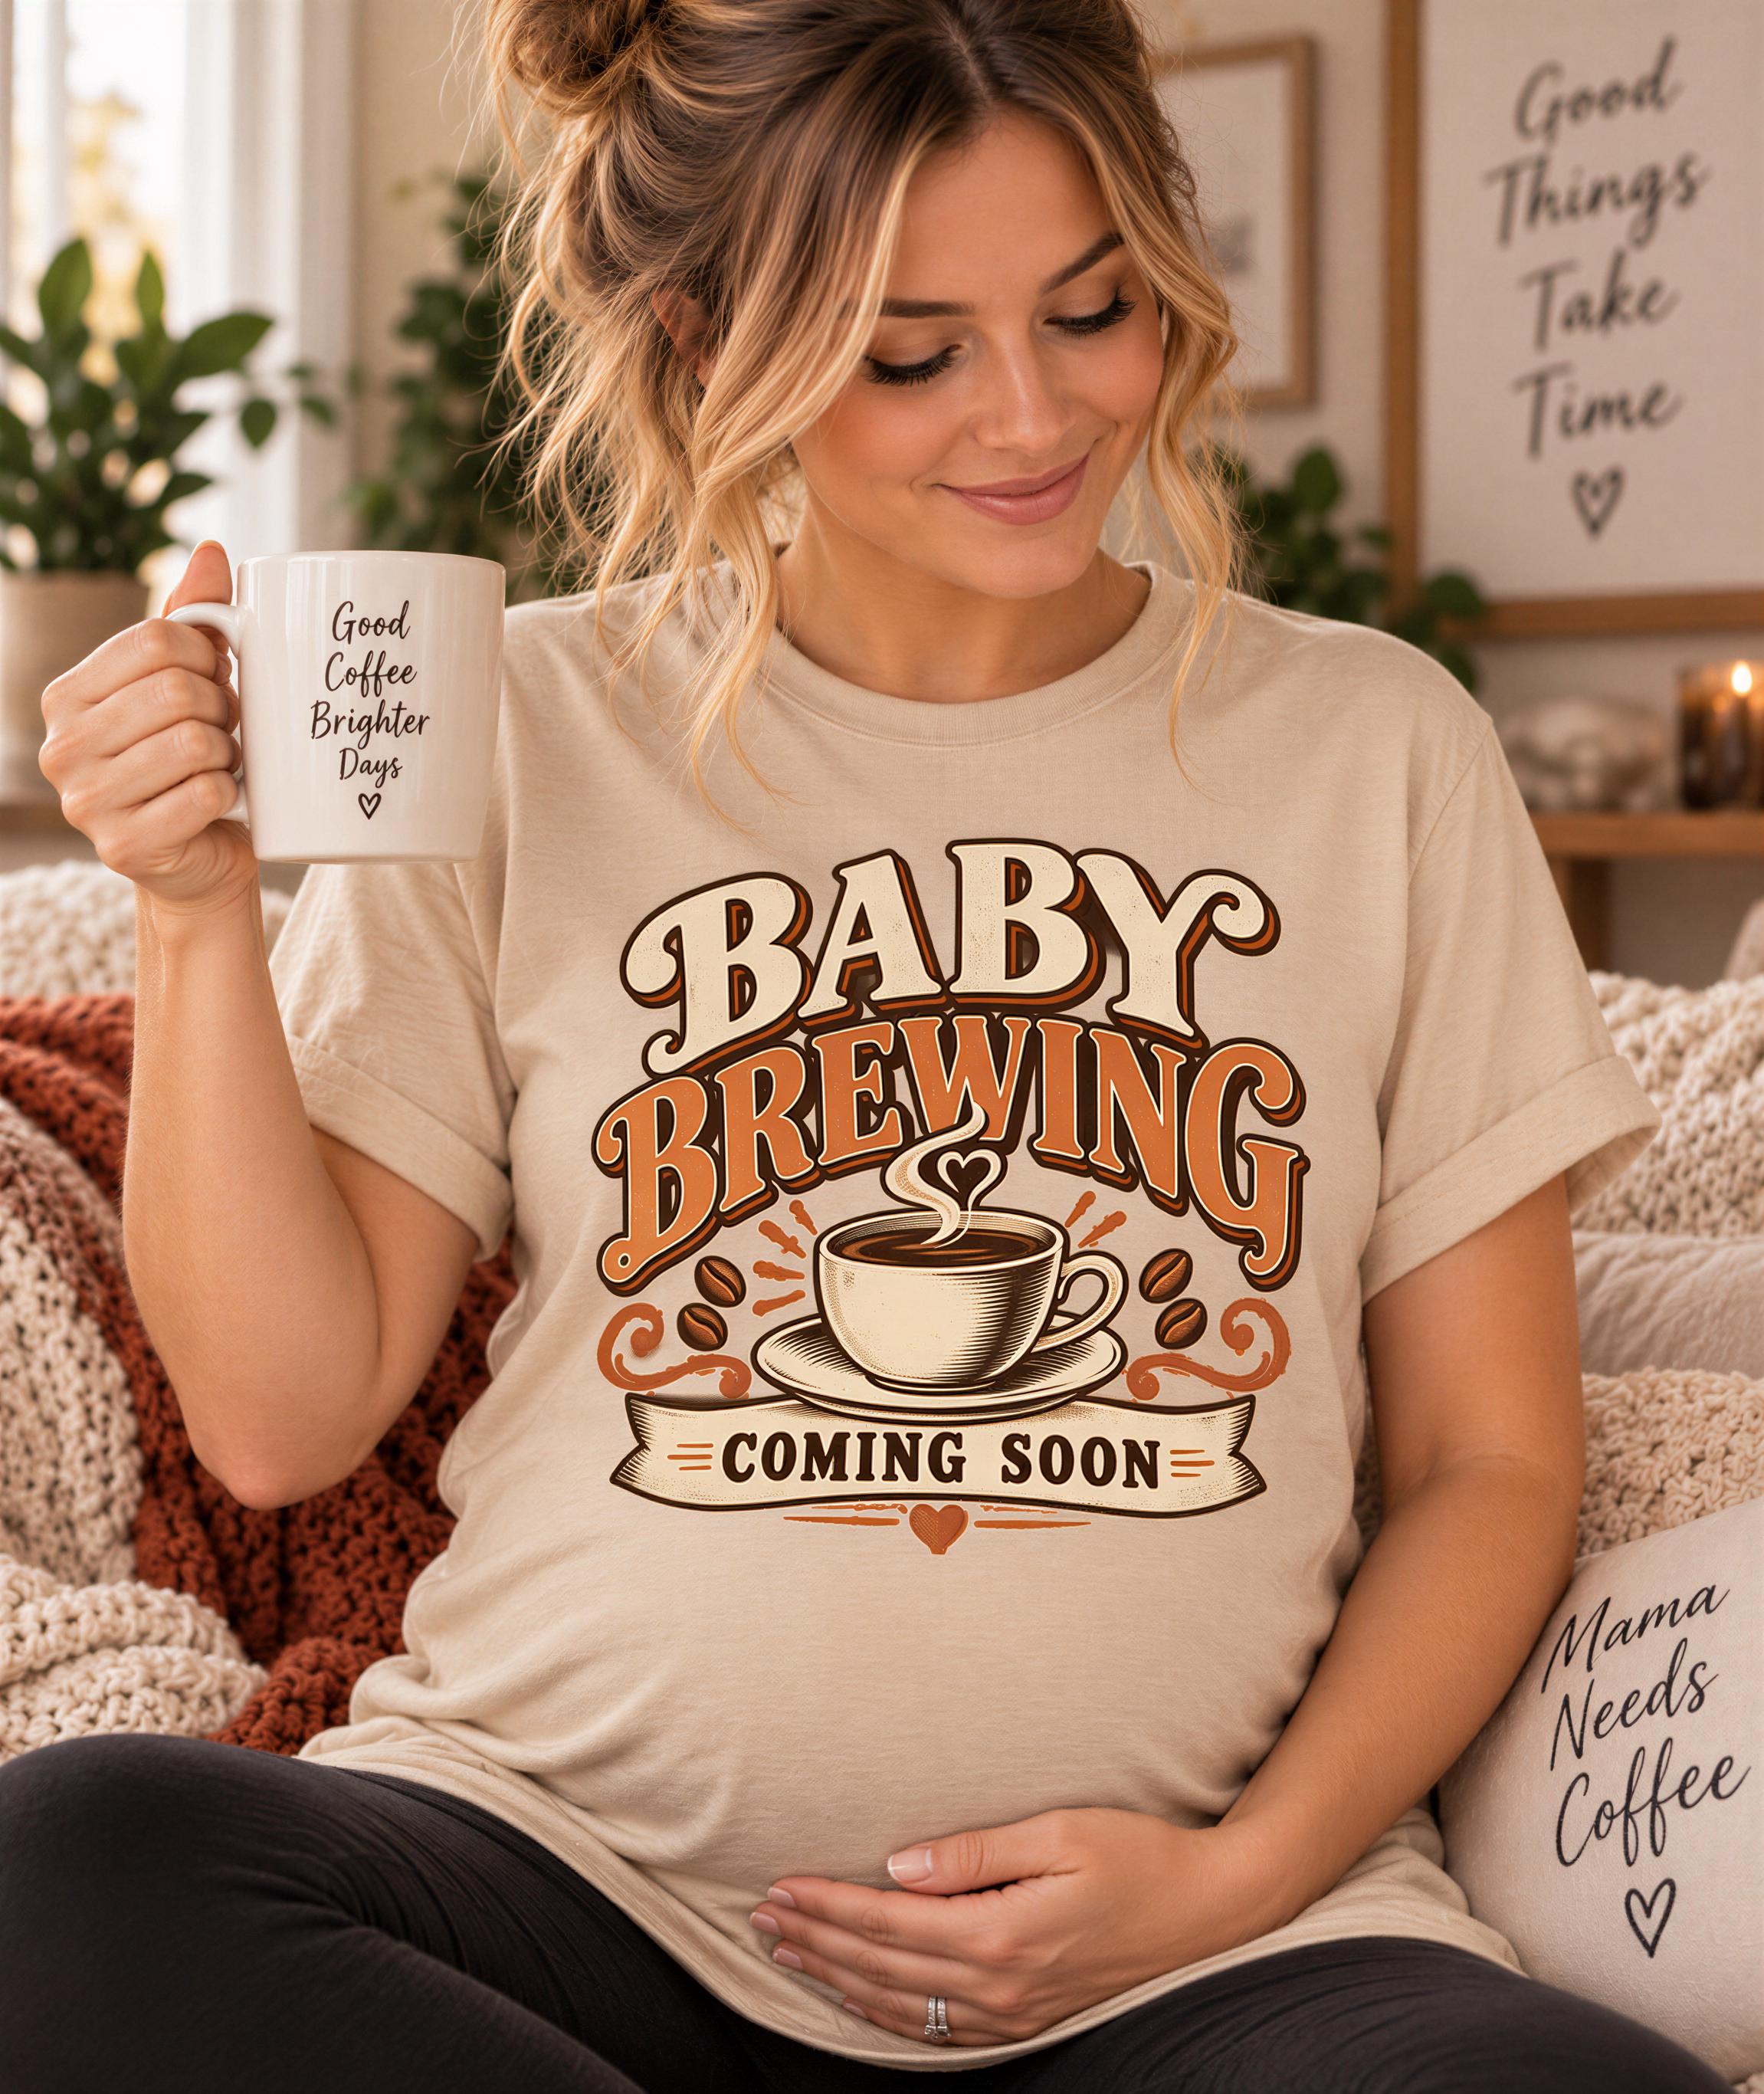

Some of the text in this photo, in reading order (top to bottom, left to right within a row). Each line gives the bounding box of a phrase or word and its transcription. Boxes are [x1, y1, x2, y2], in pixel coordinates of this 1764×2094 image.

[1514, 33, 1684, 145] Good
[1482, 153, 1713, 251] Things
[1517, 248, 1680, 351] Take
[1511, 361, 1684, 462] Time
[332, 600, 411, 644] Good
[310, 699, 430, 750] Brighter
[325, 650, 417, 697] Coffee
[339, 747, 403, 789] Days
[620, 839, 1281, 1075] BABY
[592, 1012, 1310, 1296] BREWING
[722, 1431, 1162, 1489] COMING SOON
[1541, 1584, 1731, 1694] Mama
[1550, 1637, 1720, 1771] Needs
[1556, 1737, 1752, 1867] Coffee
